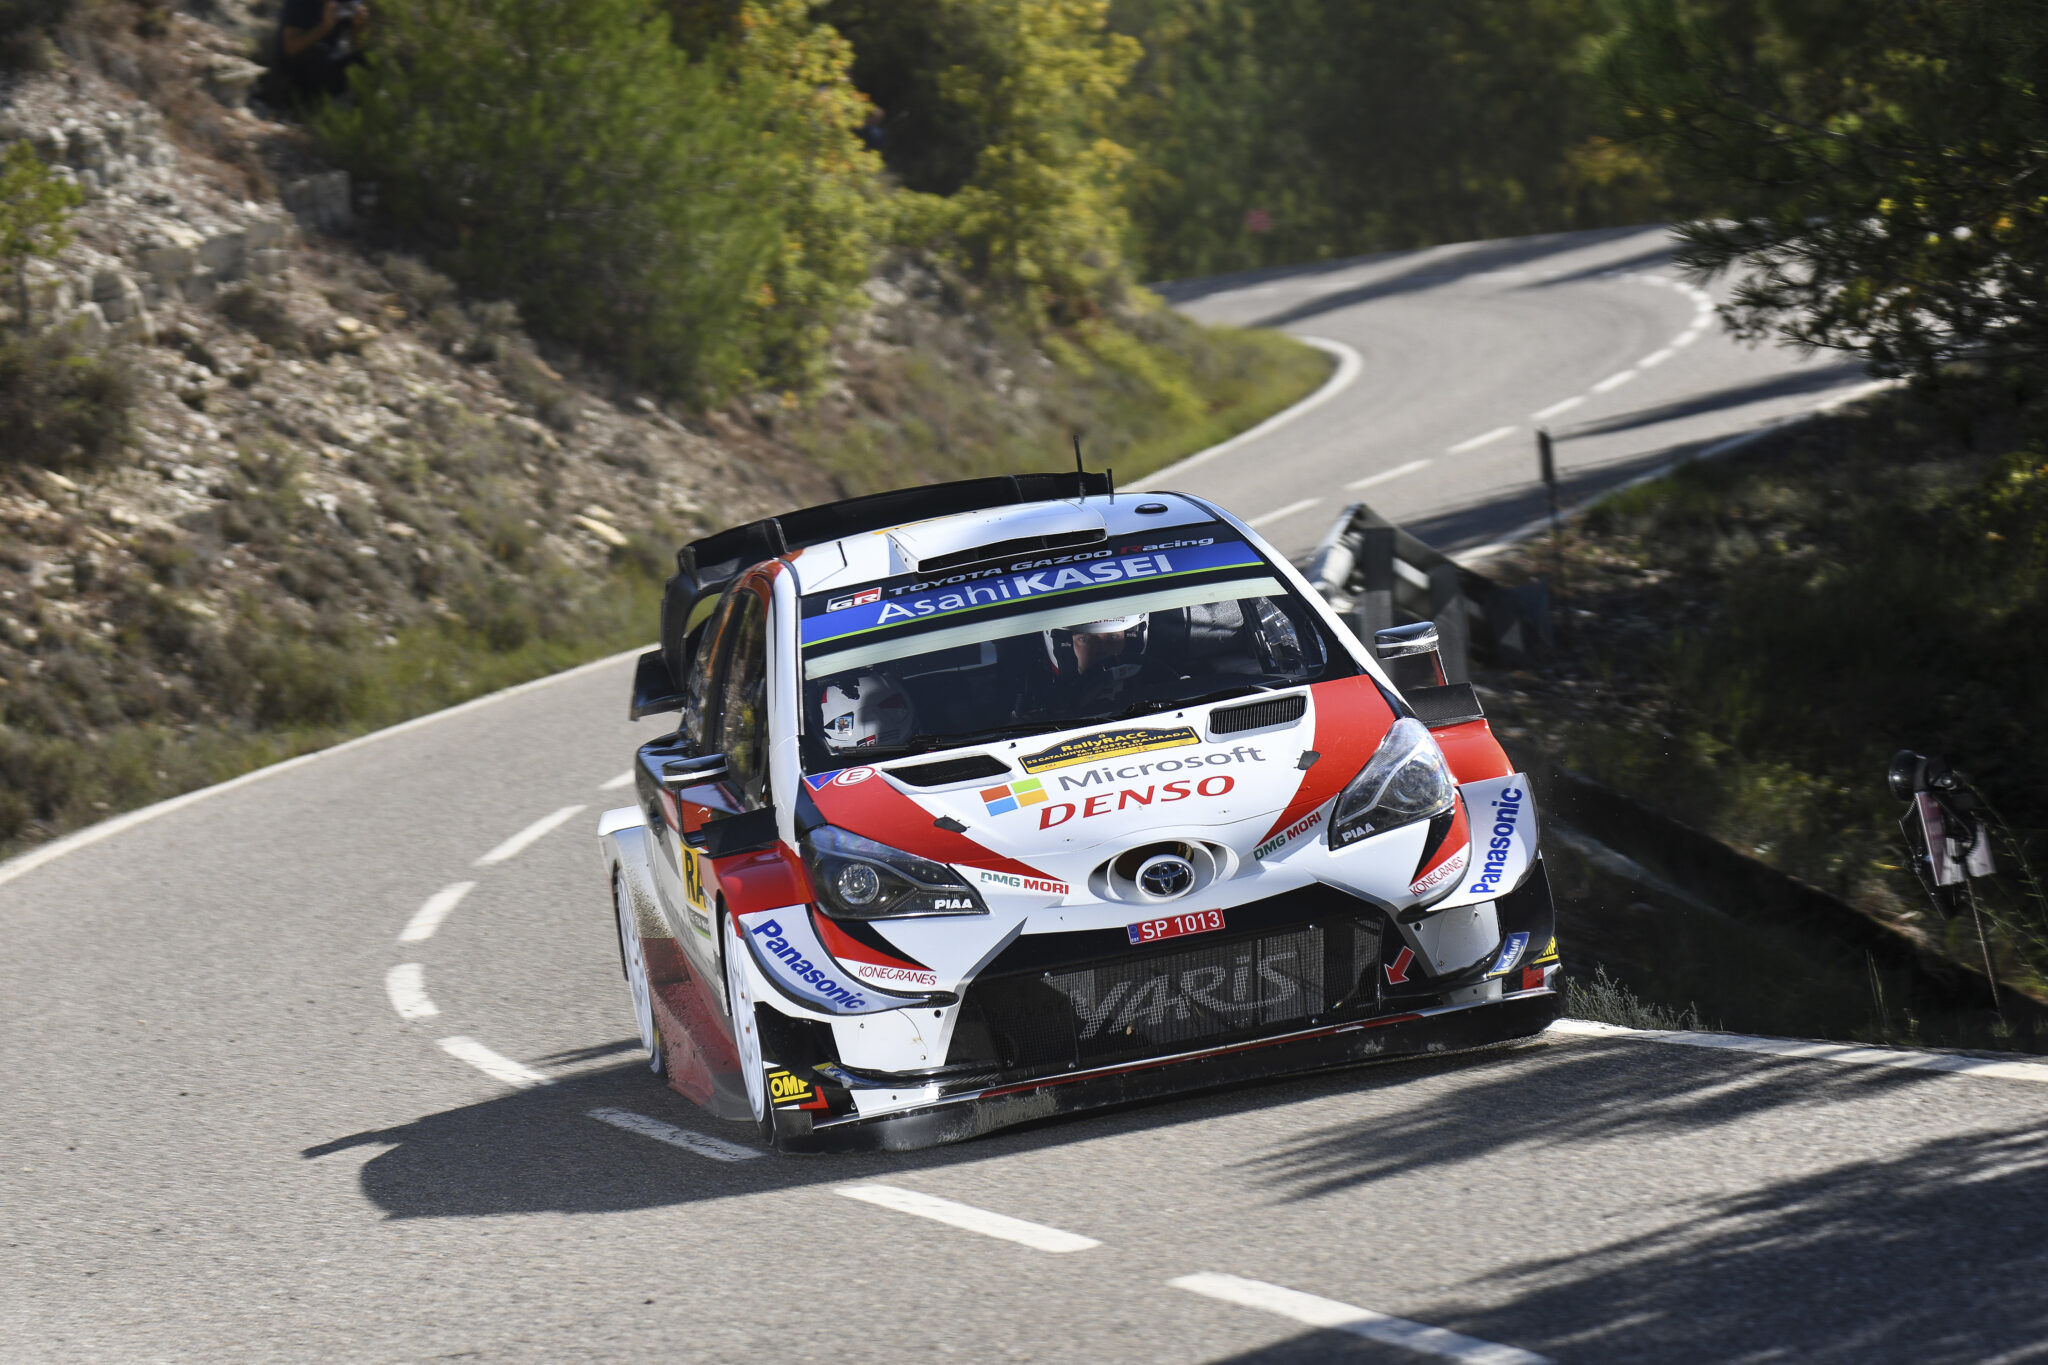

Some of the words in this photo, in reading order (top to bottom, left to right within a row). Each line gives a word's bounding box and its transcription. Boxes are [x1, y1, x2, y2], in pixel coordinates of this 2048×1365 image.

[889, 567, 1003, 596] TOYOTA
[1010, 549, 1113, 572] GAZOO
[1120, 537, 1214, 555] Racing
[829, 592, 879, 609] GR
[1060, 731, 1149, 752] RallyRACC
[1132, 732, 1190, 744] DAURADA
[1058, 746, 1266, 791] Microsoft
[1038, 775, 1236, 831] DENSO
[1253, 834, 1287, 861] DMG
[1286, 811, 1322, 841] MORI
[1341, 822, 1376, 843] PIAA
[1469, 787, 1523, 894] Panasonic
[980, 871, 1021, 888] DMG
[1023, 878, 1069, 895] MORI
[1409, 856, 1465, 897] KONECRANES
[934, 898, 973, 911] PIAA
[1141, 920, 1168, 940] SP
[1174, 911, 1221, 934] 1013
[751, 918, 867, 1010] Panasonic
[858, 965, 937, 986] KONECRANES
[770, 1074, 809, 1098] OMP
